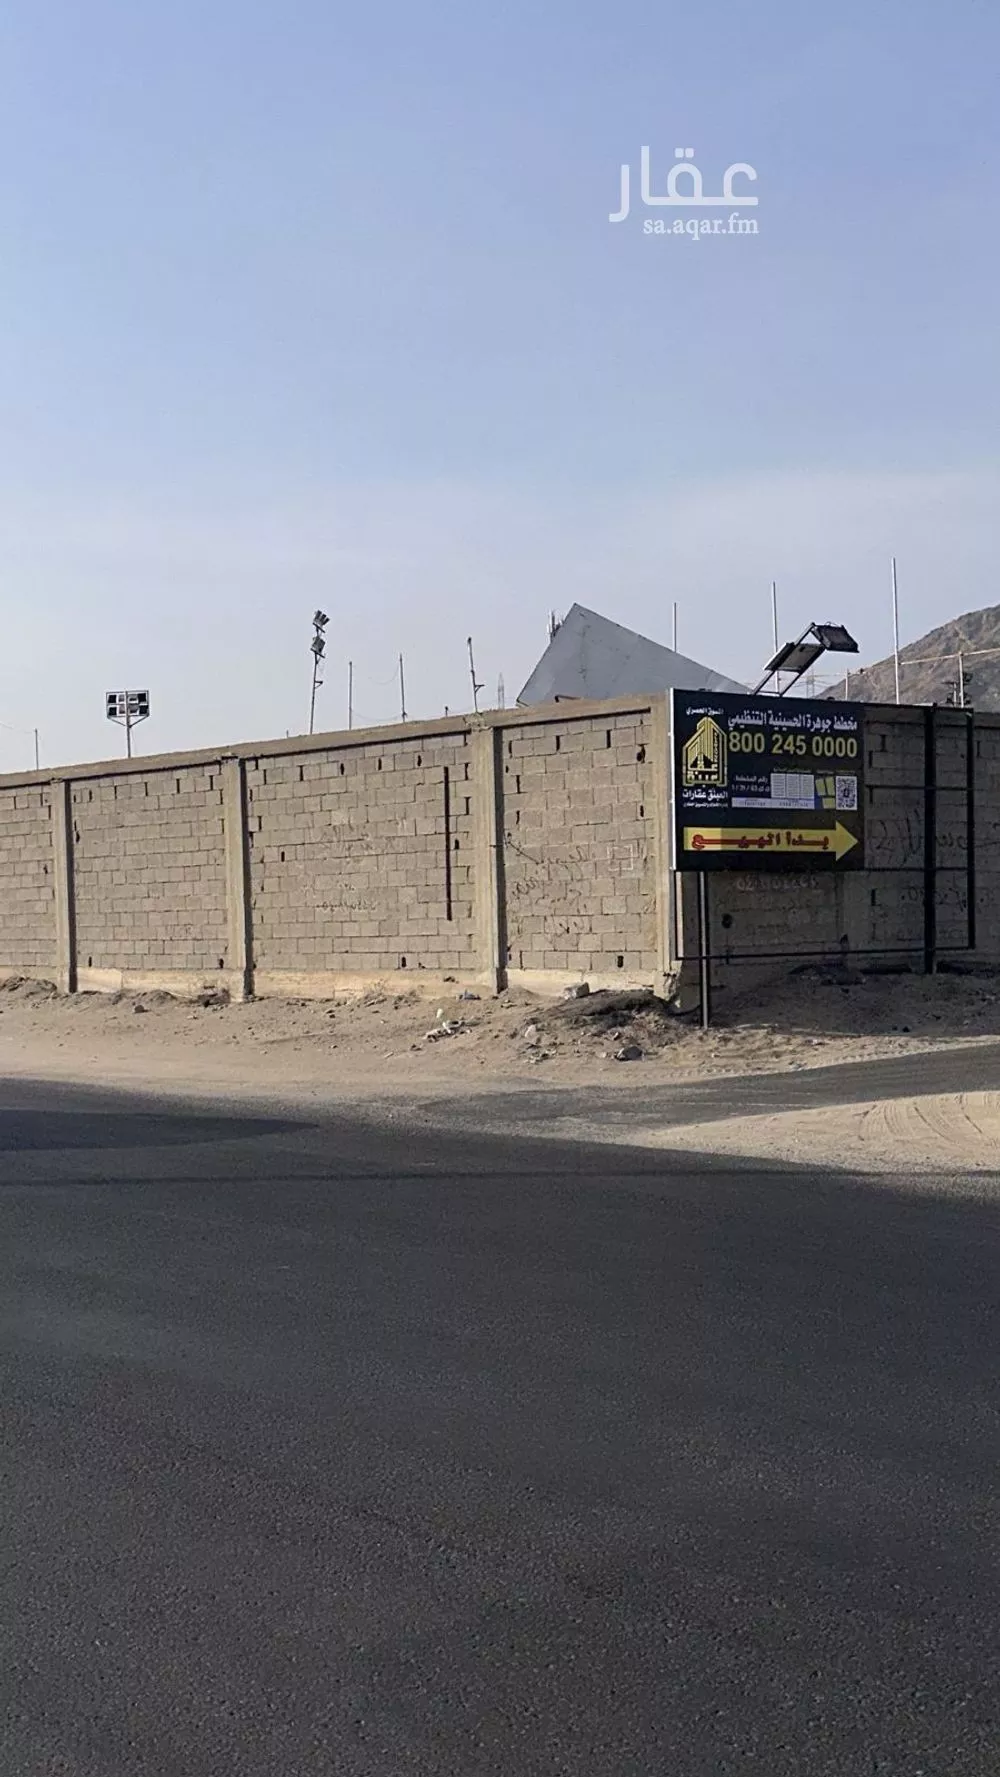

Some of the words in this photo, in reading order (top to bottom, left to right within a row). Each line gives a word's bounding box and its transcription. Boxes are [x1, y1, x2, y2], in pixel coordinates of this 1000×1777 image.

[727, 709, 768, 731] التنظيمي
[768, 709, 806, 731] الحسينية
[806, 713, 832, 733] جوهرة
[833, 715, 858, 731] مخطط
[728, 731, 765, 753] 800
[771, 733, 807, 755] 245
[811, 735, 858, 758] 0000
[682, 788, 707, 800] عقارات
[691, 832, 781, 850] البيع
